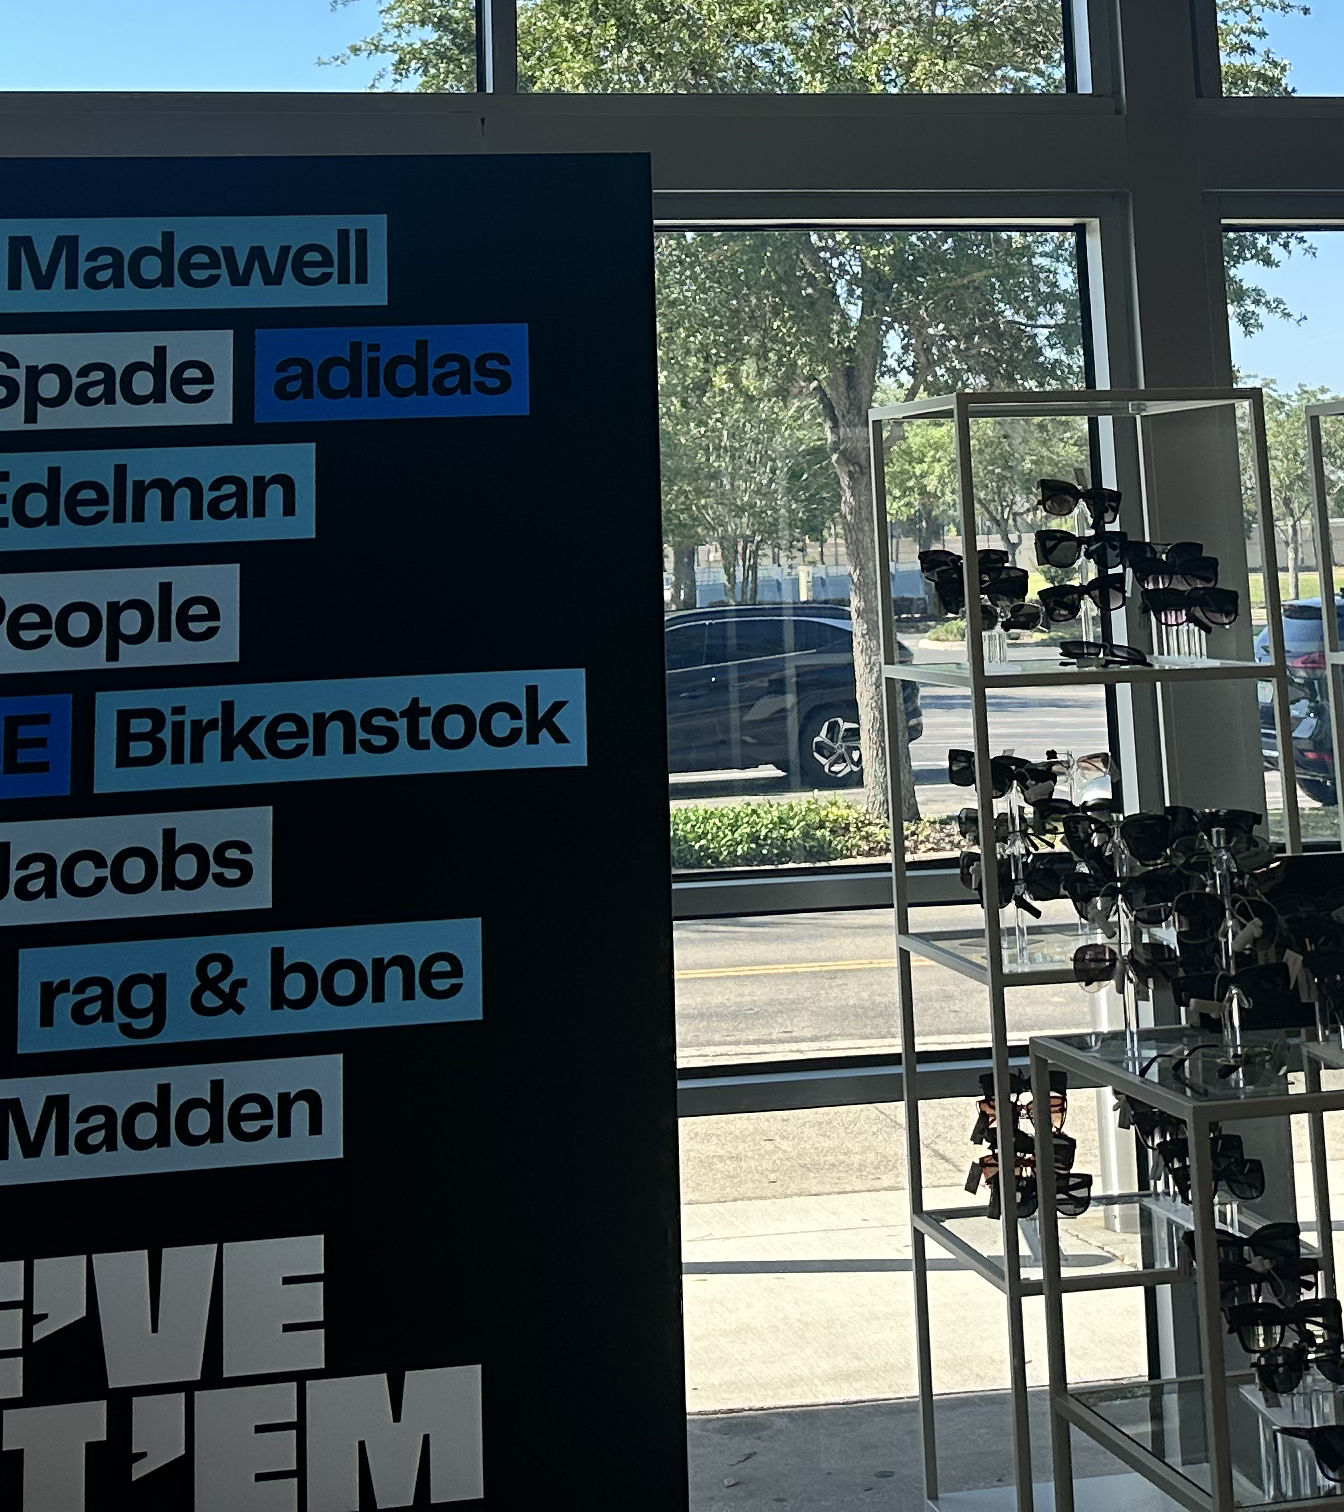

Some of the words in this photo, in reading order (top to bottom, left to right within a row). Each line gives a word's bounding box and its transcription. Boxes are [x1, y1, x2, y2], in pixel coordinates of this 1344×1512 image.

[8, 228, 368, 290] Madewell
[274, 339, 512, 401] adidas
[115, 685, 570, 768] Birkenstock
[40, 973, 167, 1040] rag
[190, 953, 248, 1017] &
[270, 947, 463, 1010] bone
